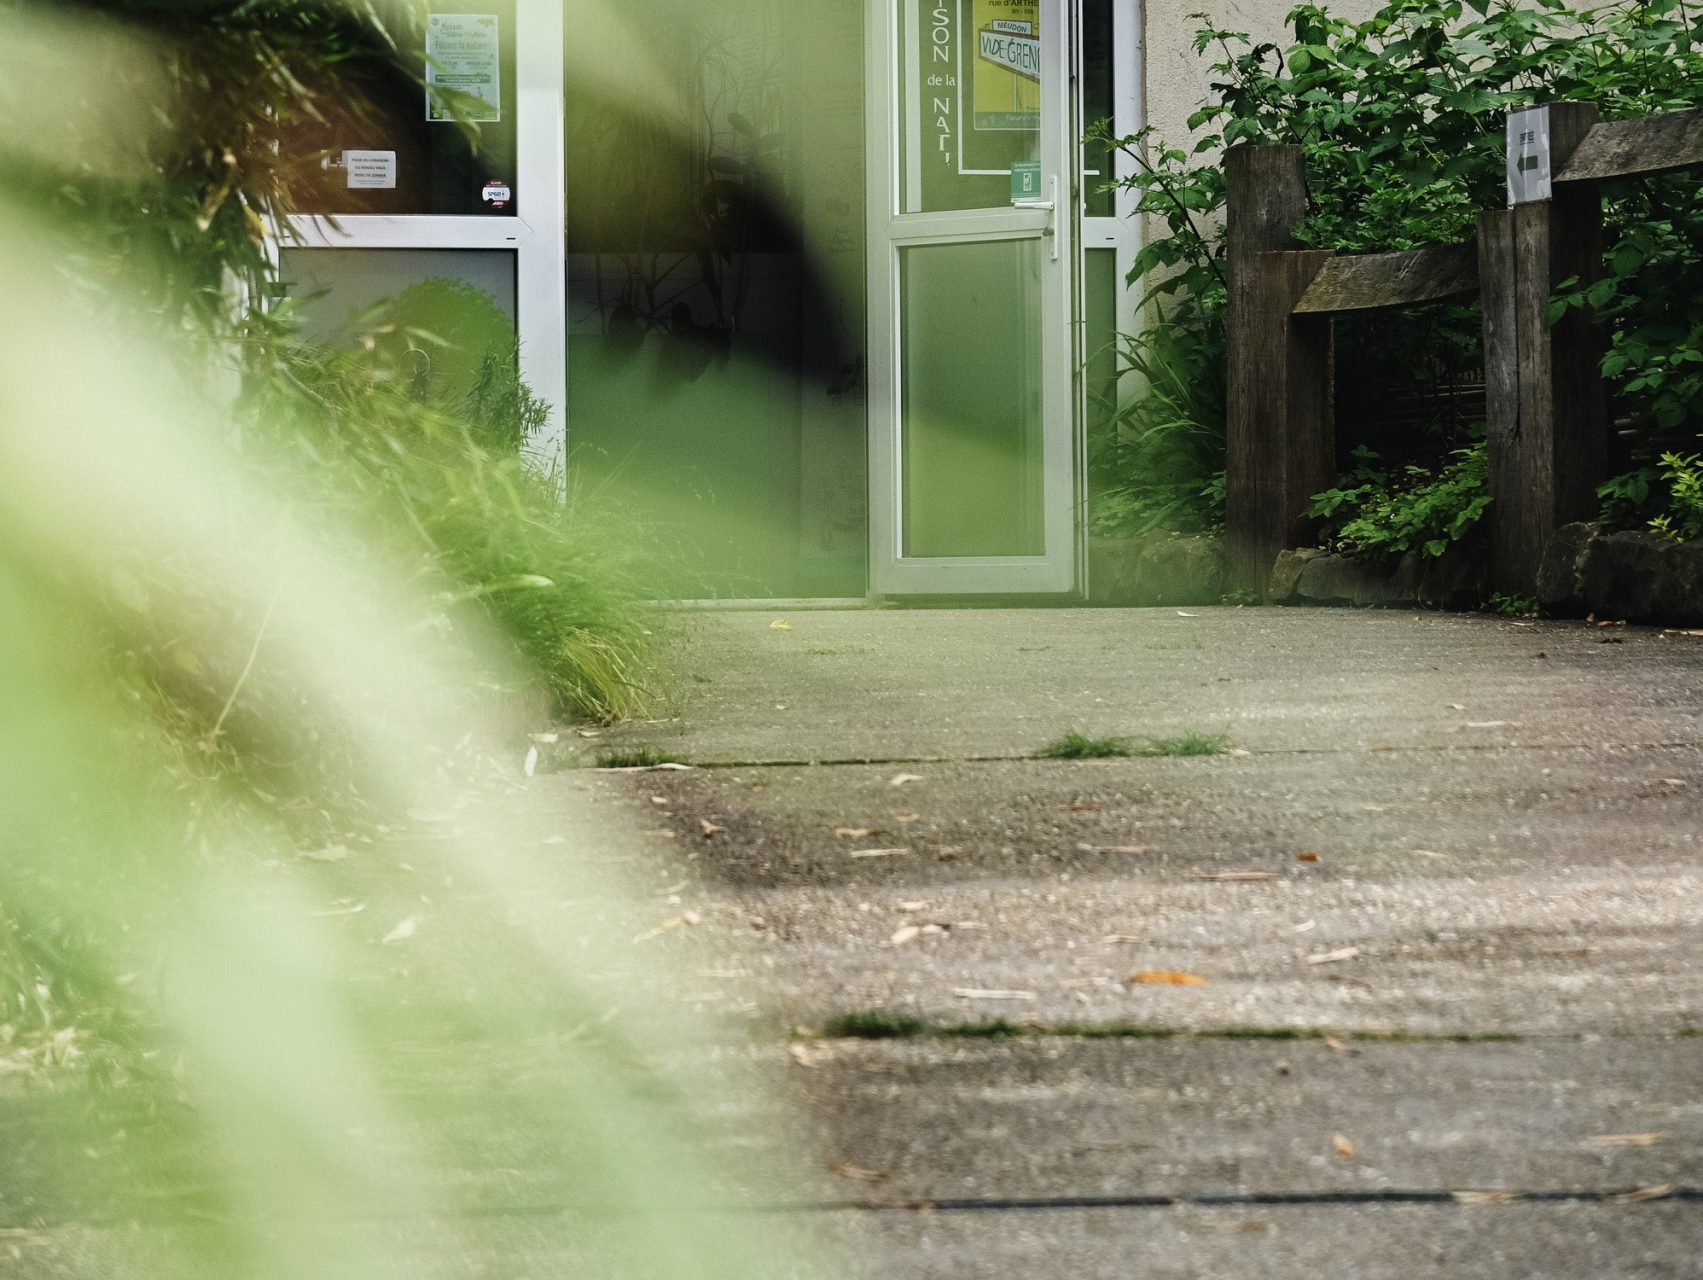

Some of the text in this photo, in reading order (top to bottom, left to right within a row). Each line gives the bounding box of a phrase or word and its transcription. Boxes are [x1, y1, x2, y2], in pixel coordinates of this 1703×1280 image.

[997, 22, 1027, 33] MEUDON
[927, 73, 942, 86] de
[945, 73, 956, 86] la
